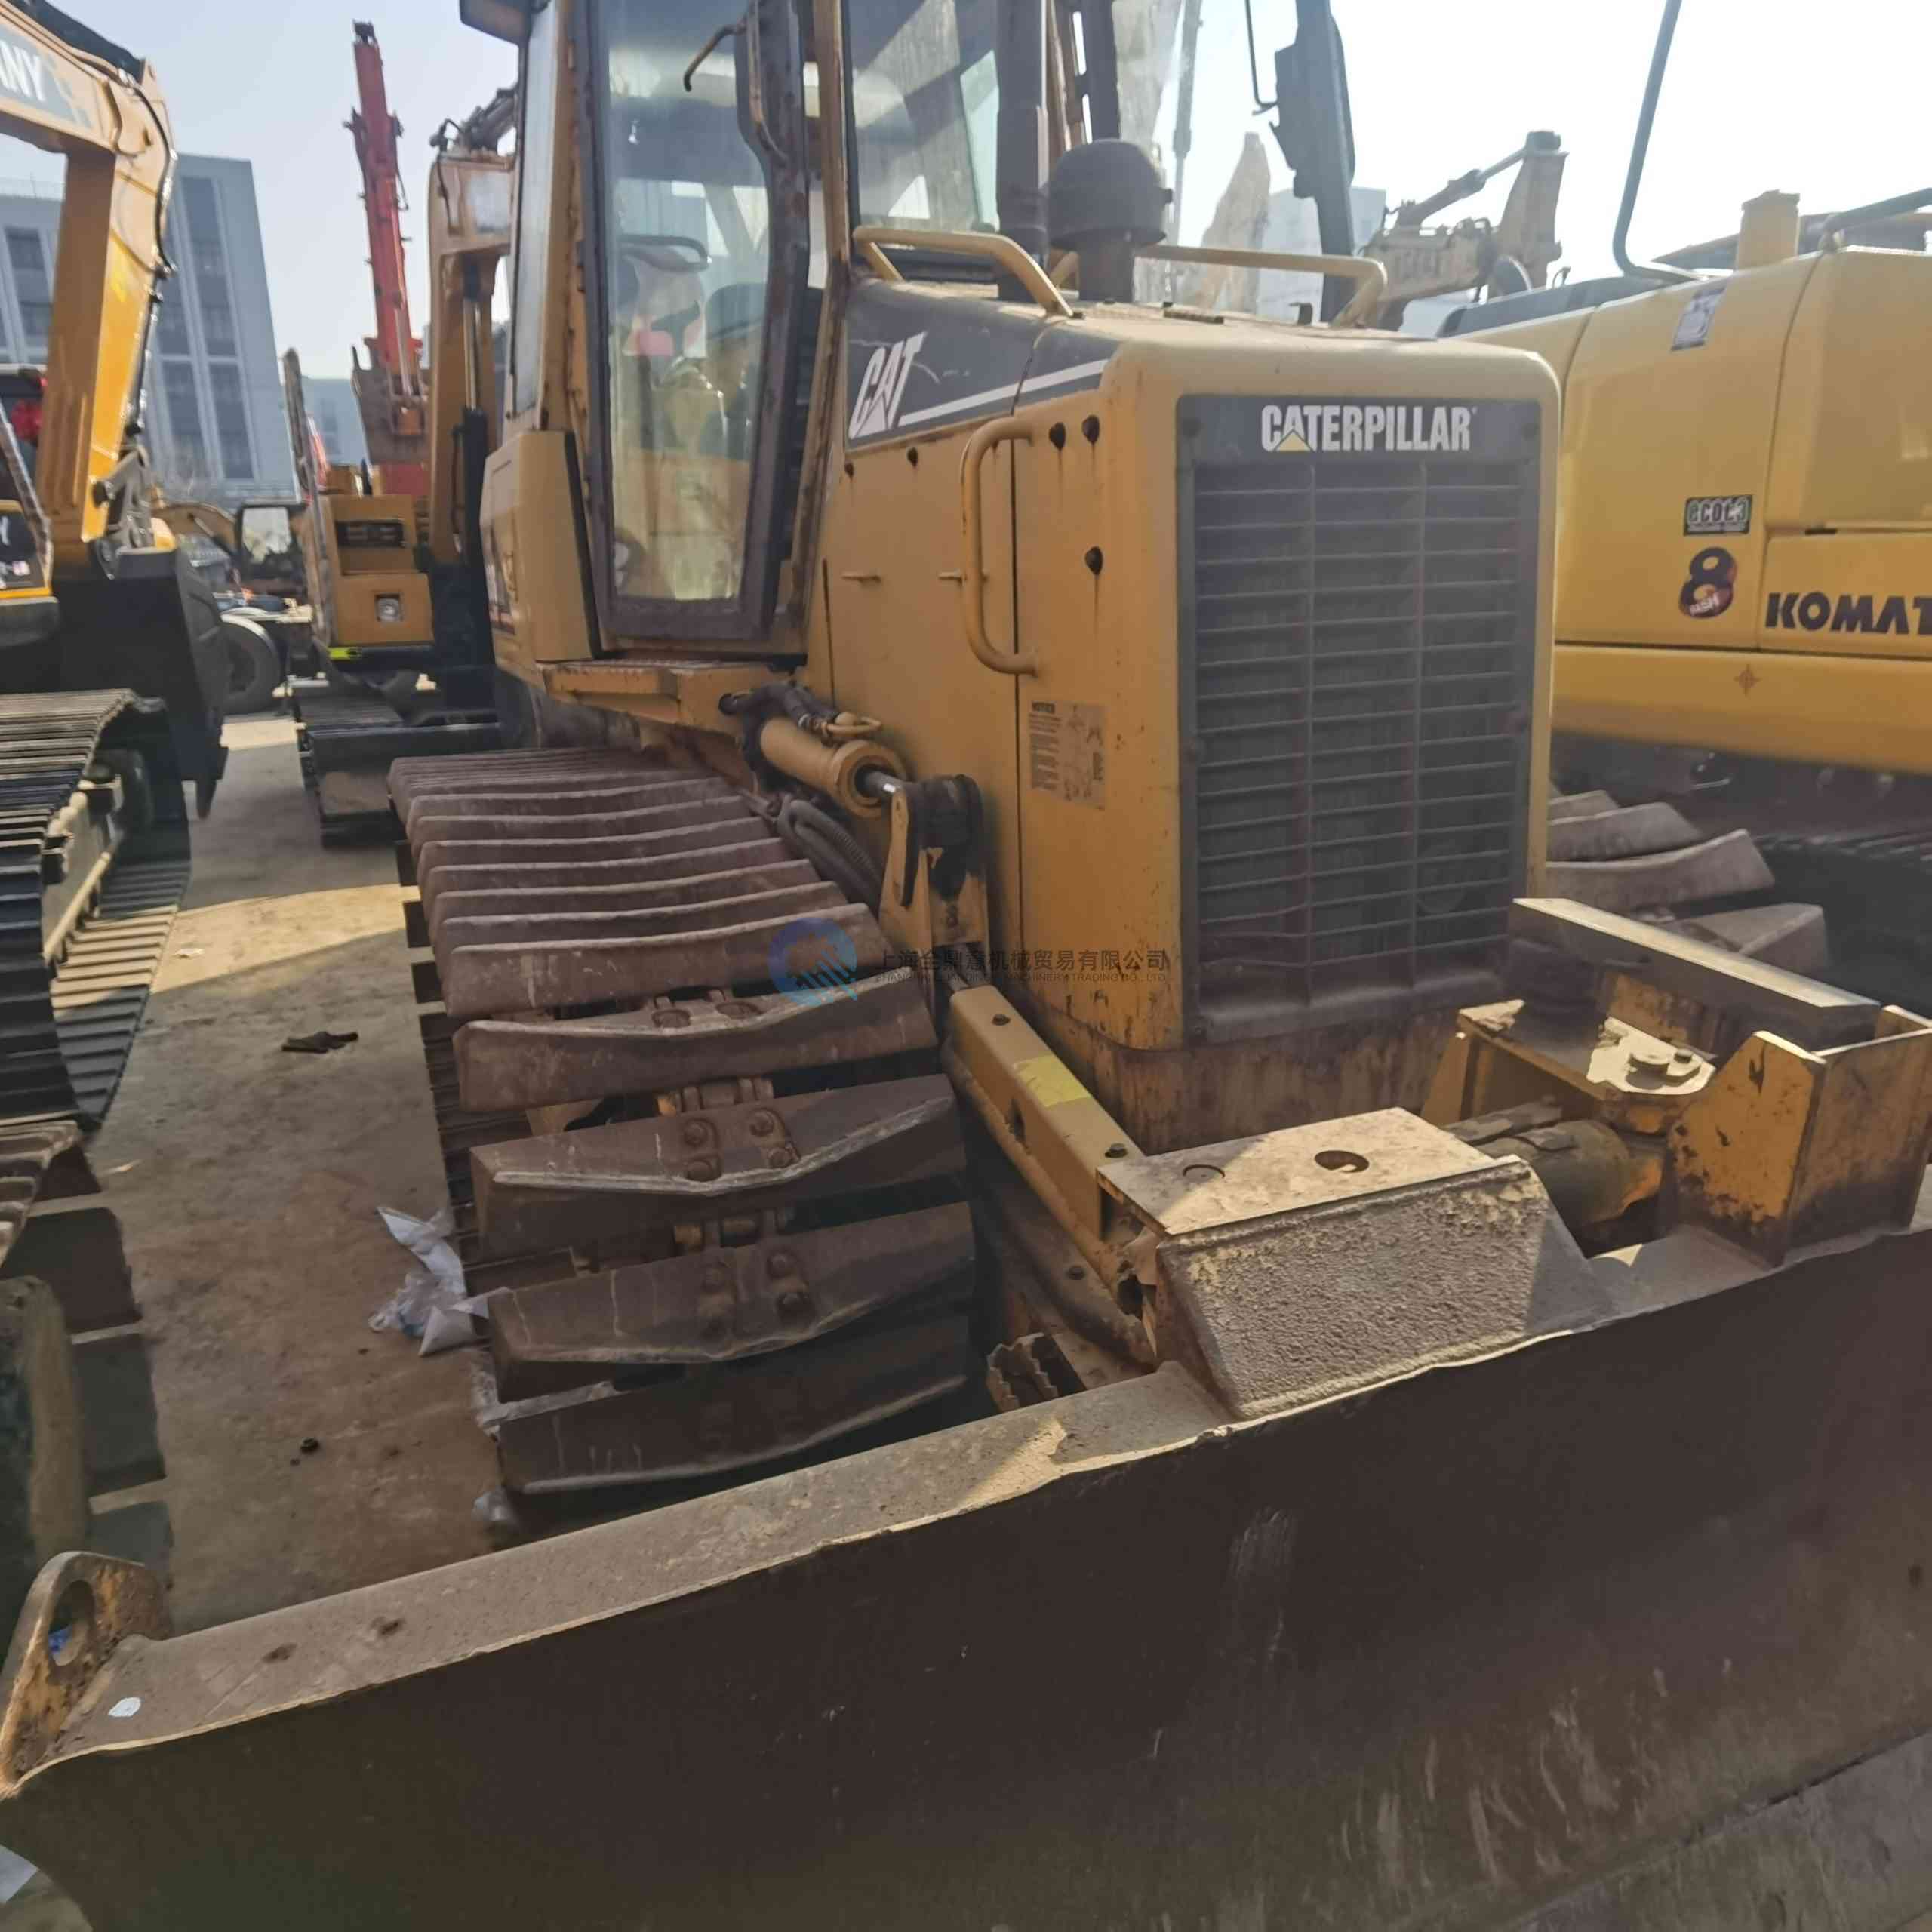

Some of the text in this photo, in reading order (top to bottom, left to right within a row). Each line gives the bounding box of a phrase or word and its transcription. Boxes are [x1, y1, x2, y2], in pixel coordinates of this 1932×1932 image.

[848, 332, 926, 439] CAT
[1261, 405, 1472, 452] CATERPILLAR
[1678, 547, 1737, 619] 8
